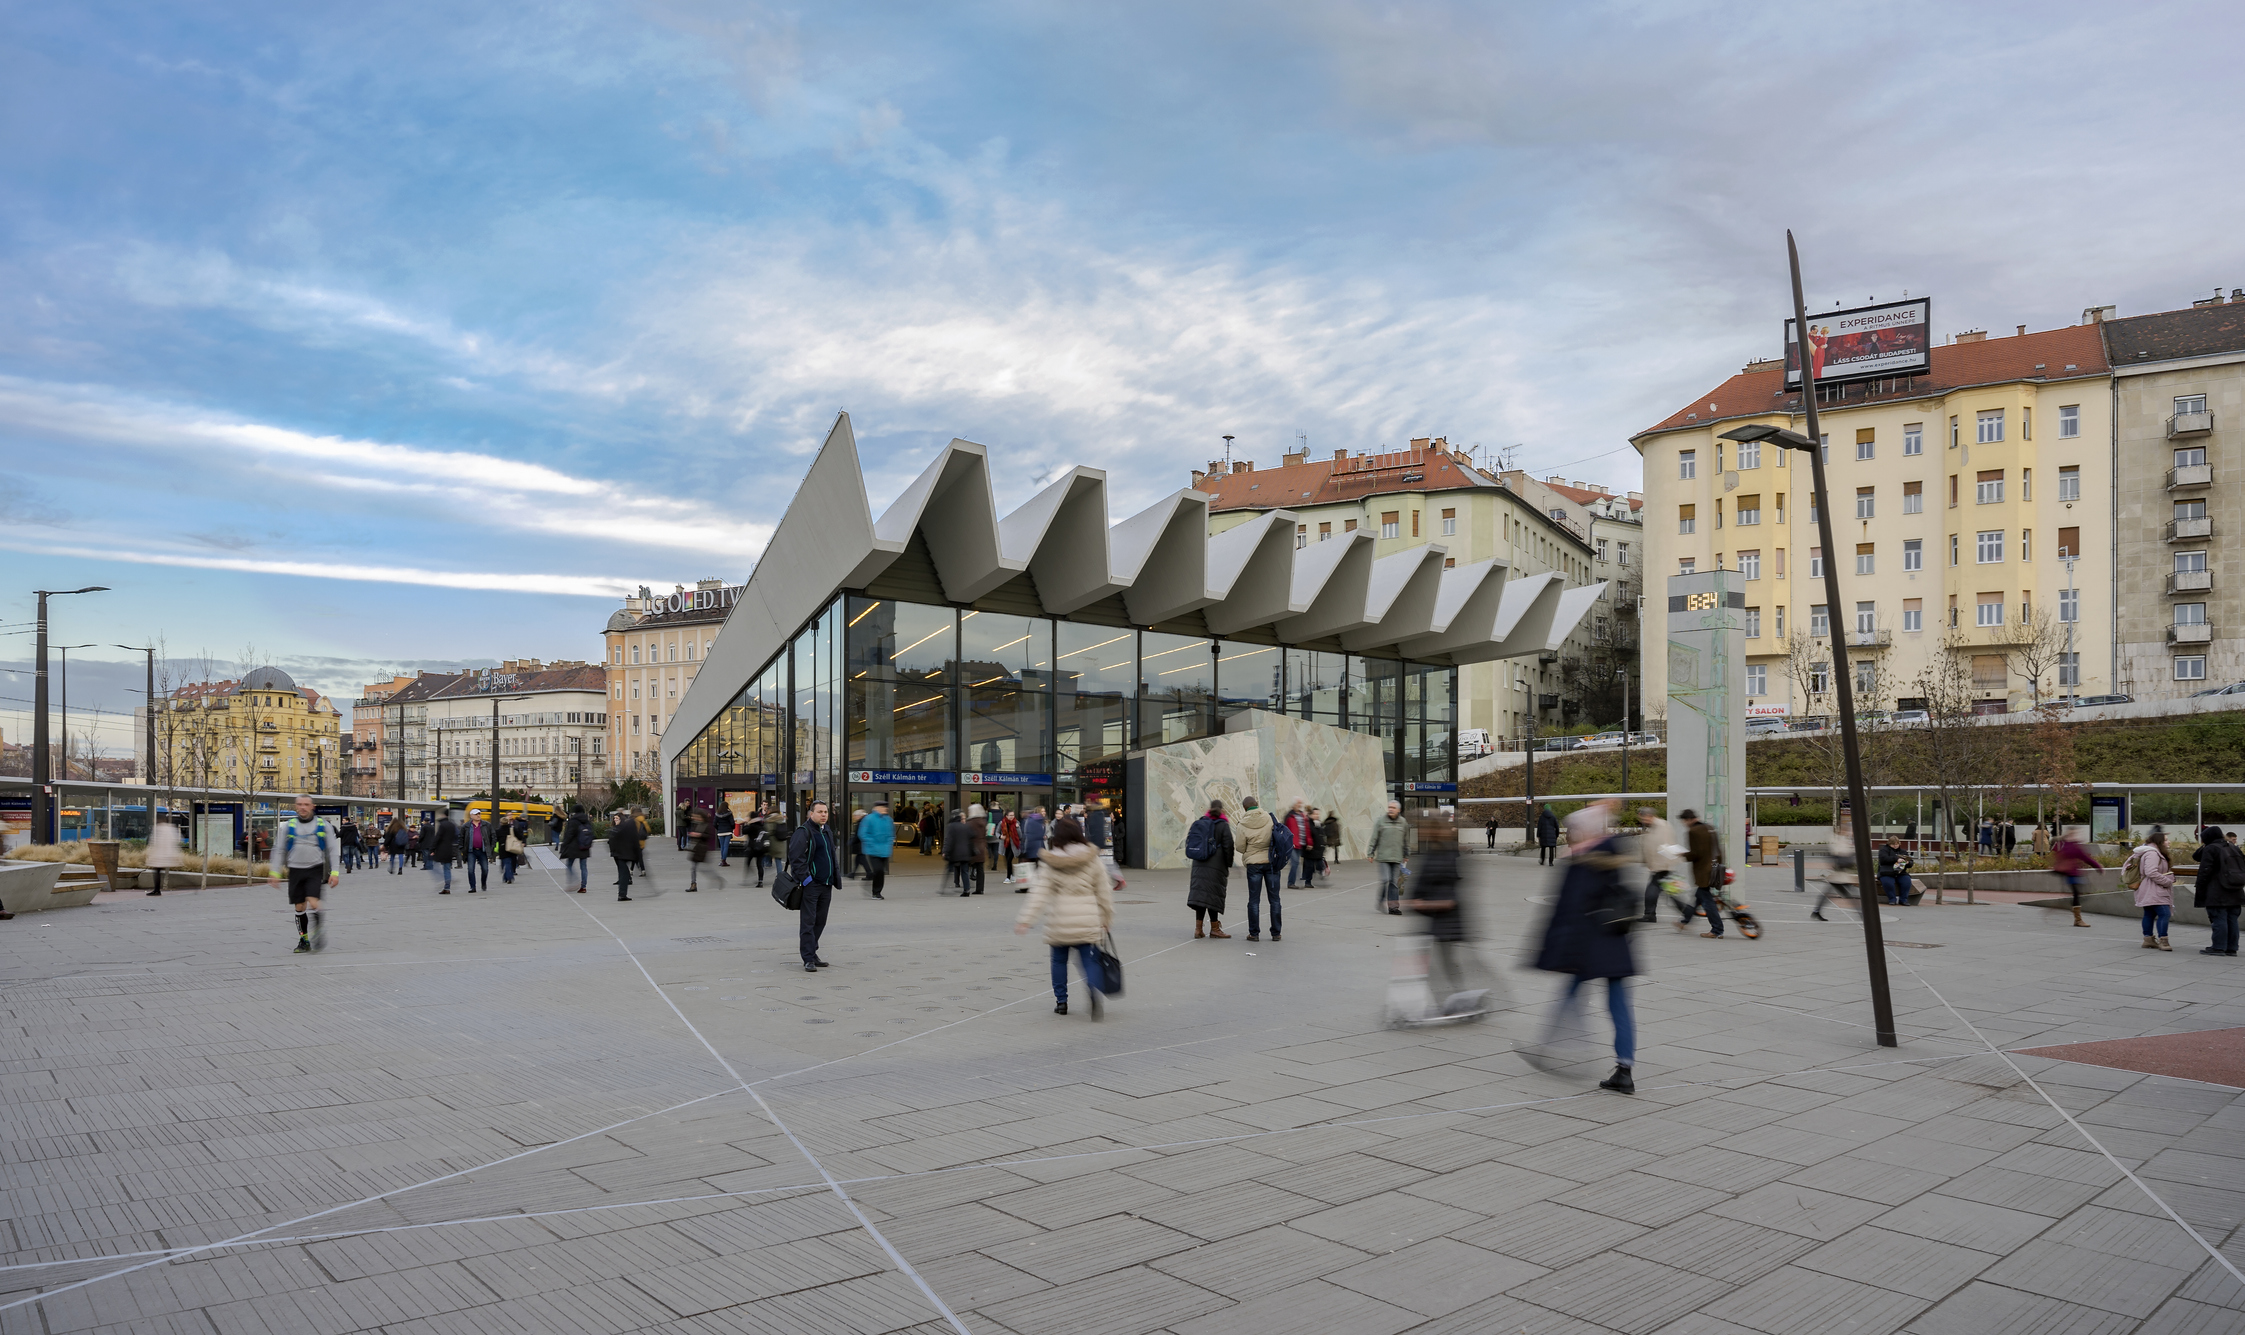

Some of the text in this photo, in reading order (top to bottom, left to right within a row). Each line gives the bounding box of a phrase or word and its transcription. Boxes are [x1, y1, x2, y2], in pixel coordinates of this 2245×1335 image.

[1840, 310, 1915, 328] EXPERIDANCE
[1851, 353, 1878, 362] CSODÁT
[1860, 358, 1916, 369] www.experidance.hu
[642, 586, 741, 616] LG OLED TV
[1687, 591, 1719, 612] 15:24
[493, 672, 516, 687] Bayer
[892, 773, 916, 781] Kálmán
